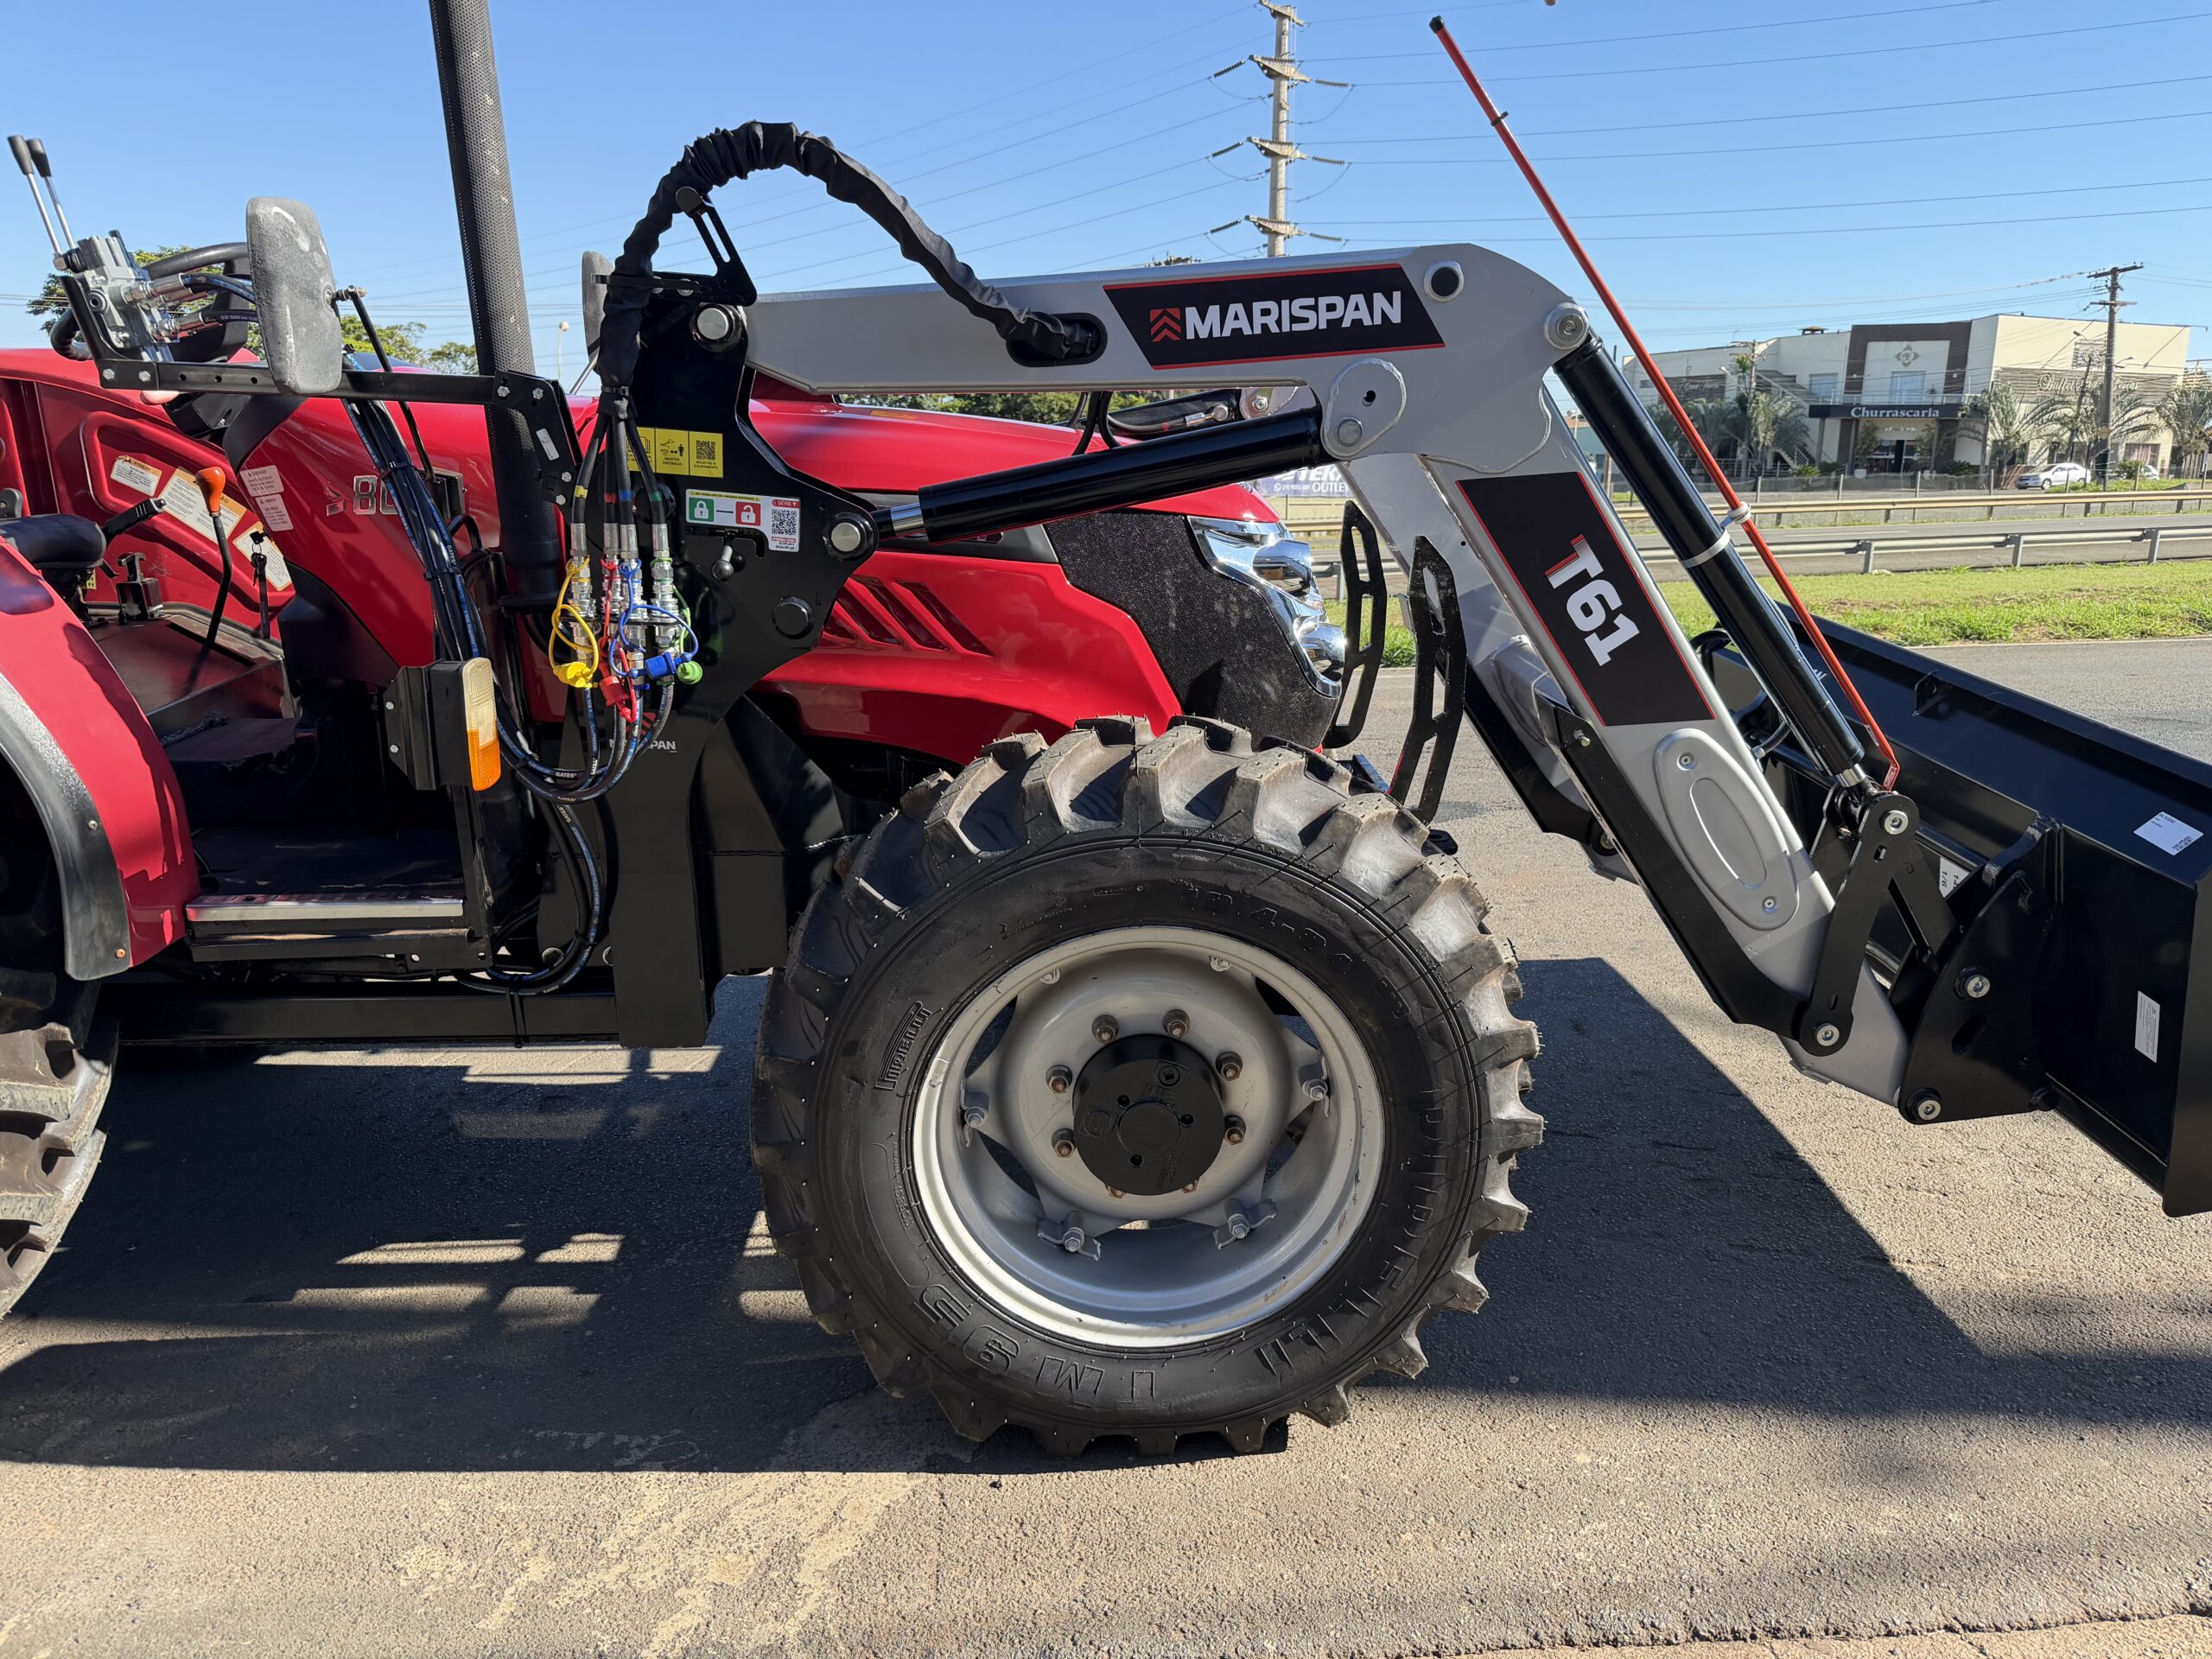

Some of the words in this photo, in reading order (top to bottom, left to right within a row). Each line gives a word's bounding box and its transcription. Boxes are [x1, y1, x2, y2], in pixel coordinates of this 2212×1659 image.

[1185, 290, 1402, 340] MARISPAN
[1851, 406, 1940, 418] Churrascaria
[1544, 534, 1640, 666] T61
[874, 1001, 933, 1090] PIRELLI
